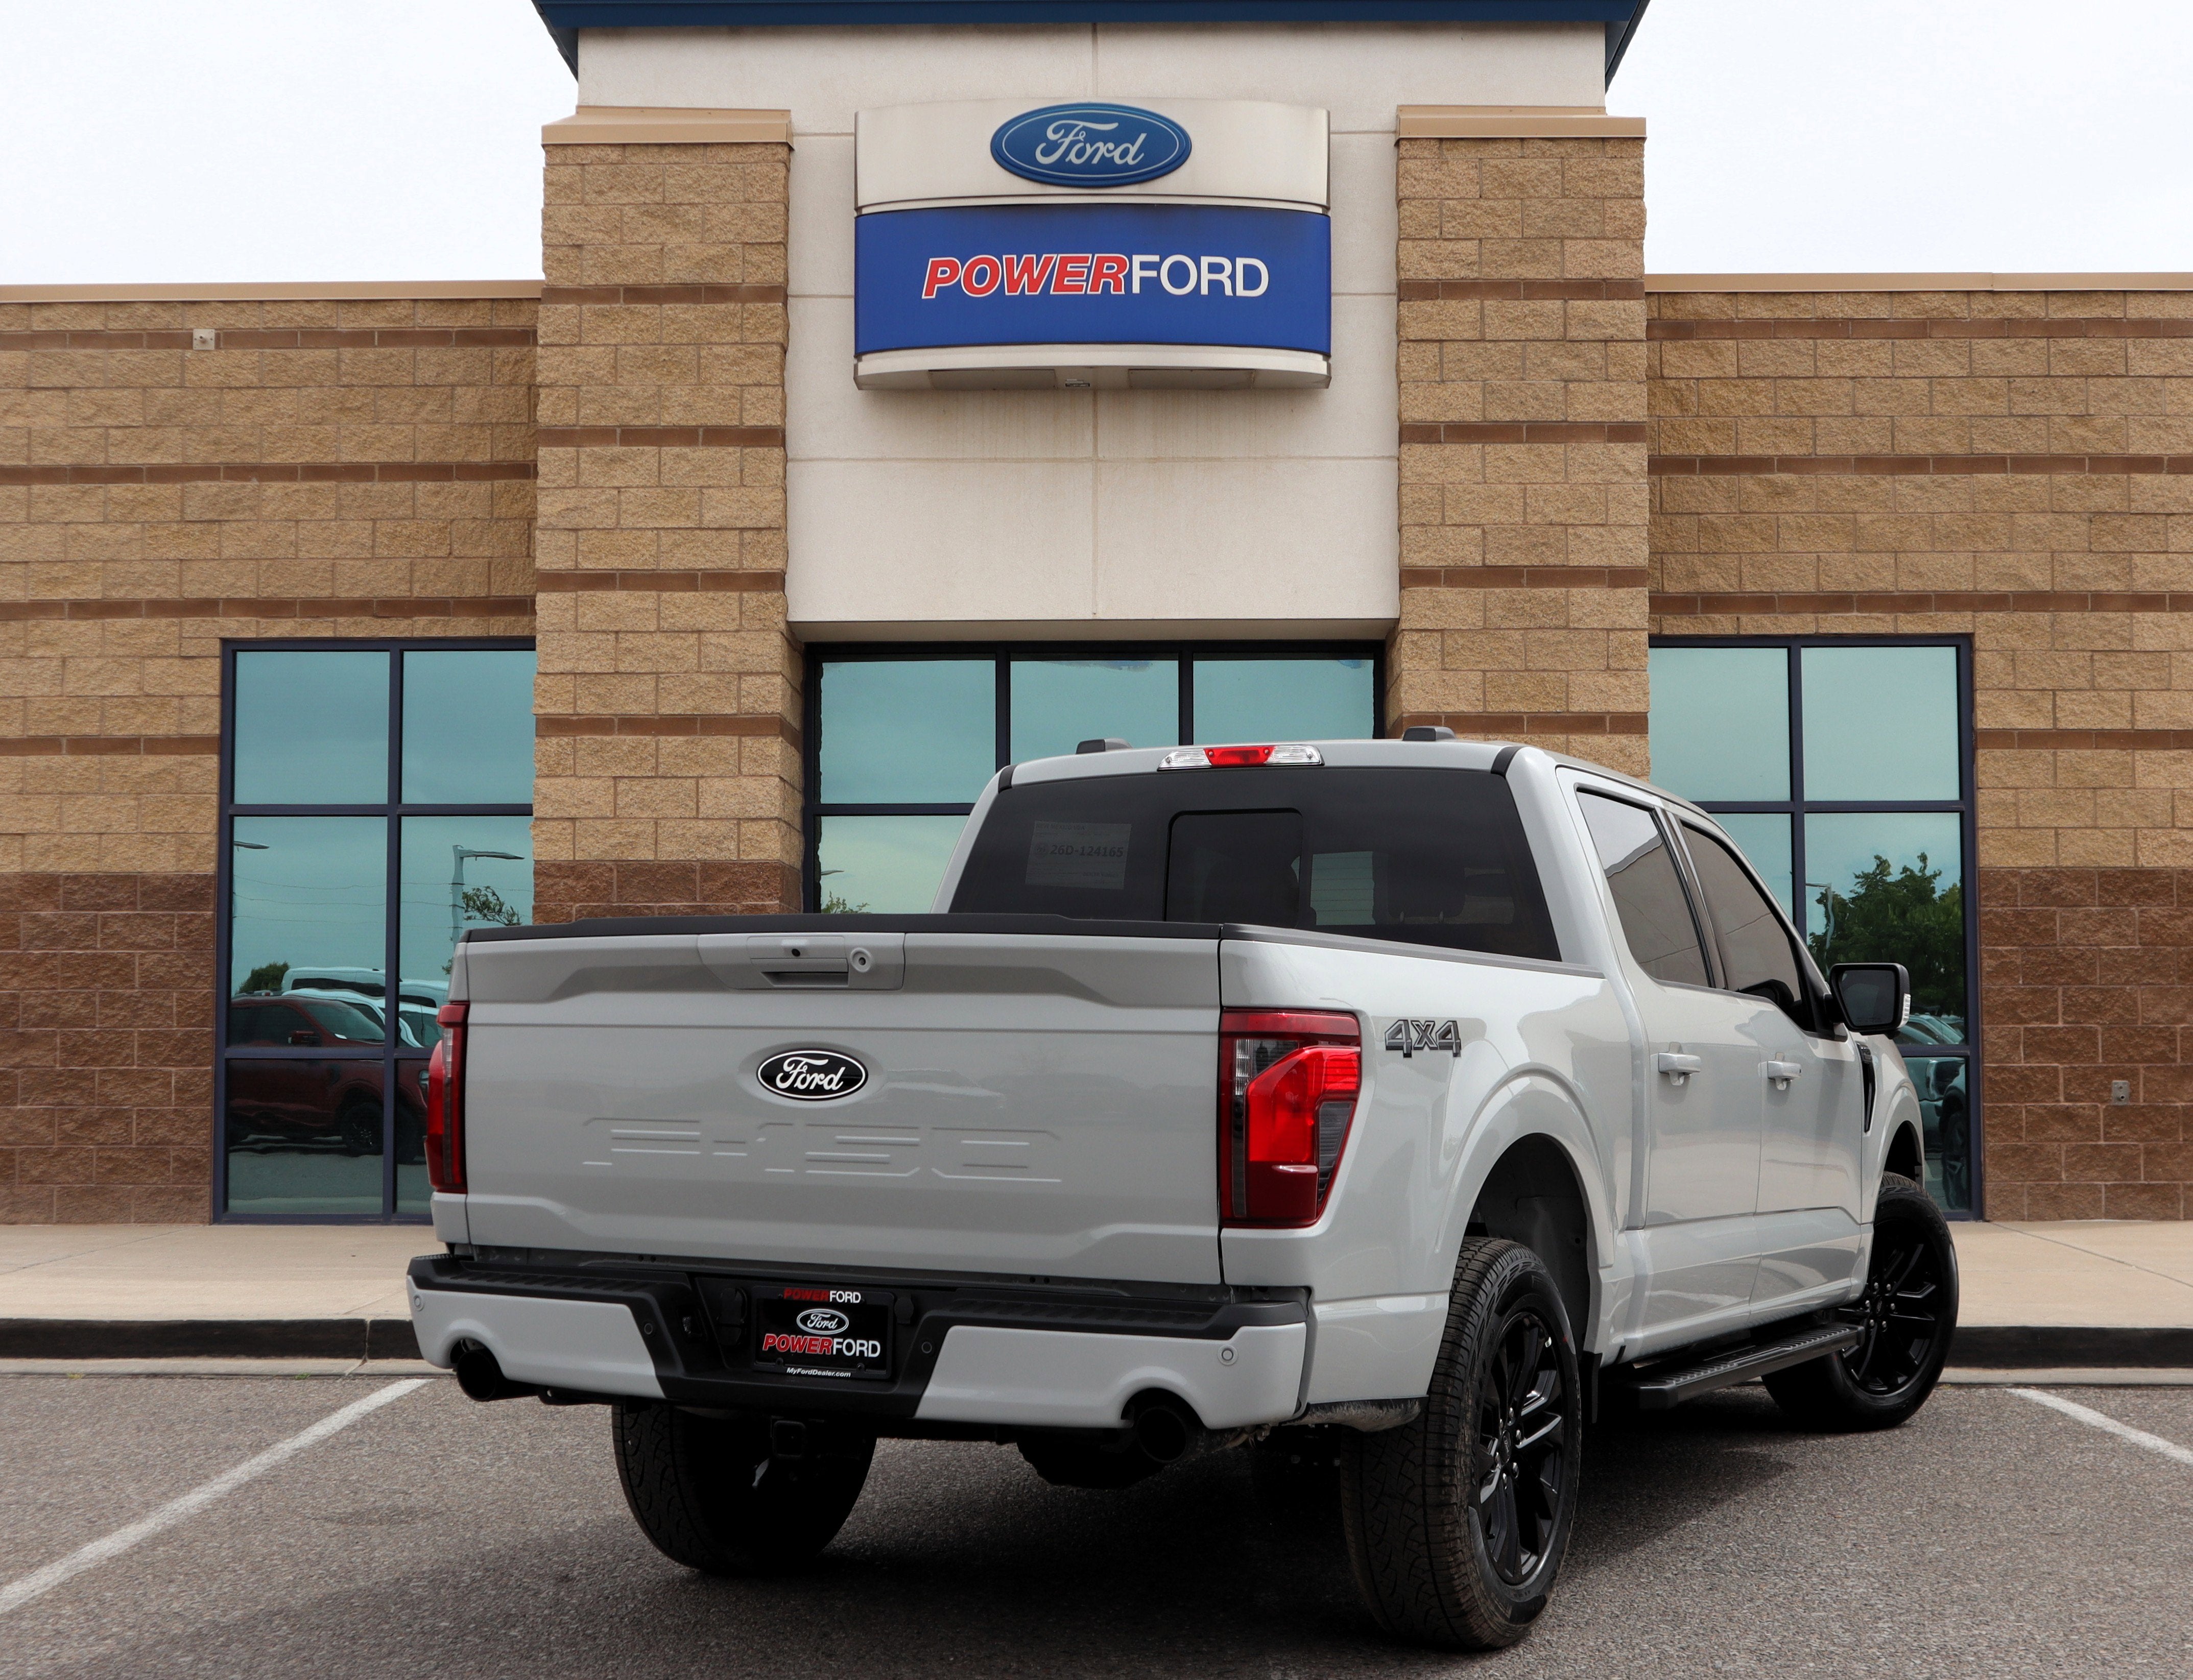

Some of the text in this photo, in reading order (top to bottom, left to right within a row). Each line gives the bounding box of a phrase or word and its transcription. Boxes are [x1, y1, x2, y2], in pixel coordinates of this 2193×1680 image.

[1034, 119, 1147, 165] Ford
[921, 253, 1270, 300] POWERFORD
[1049, 844, 1124, 858] 26D-124165
[775, 1057, 846, 1091] Ford
[806, 1312, 839, 1330] Ford
[762, 1333, 881, 1358] POWERFORD
[786, 1367, 851, 1378] MyFordDealer.com
